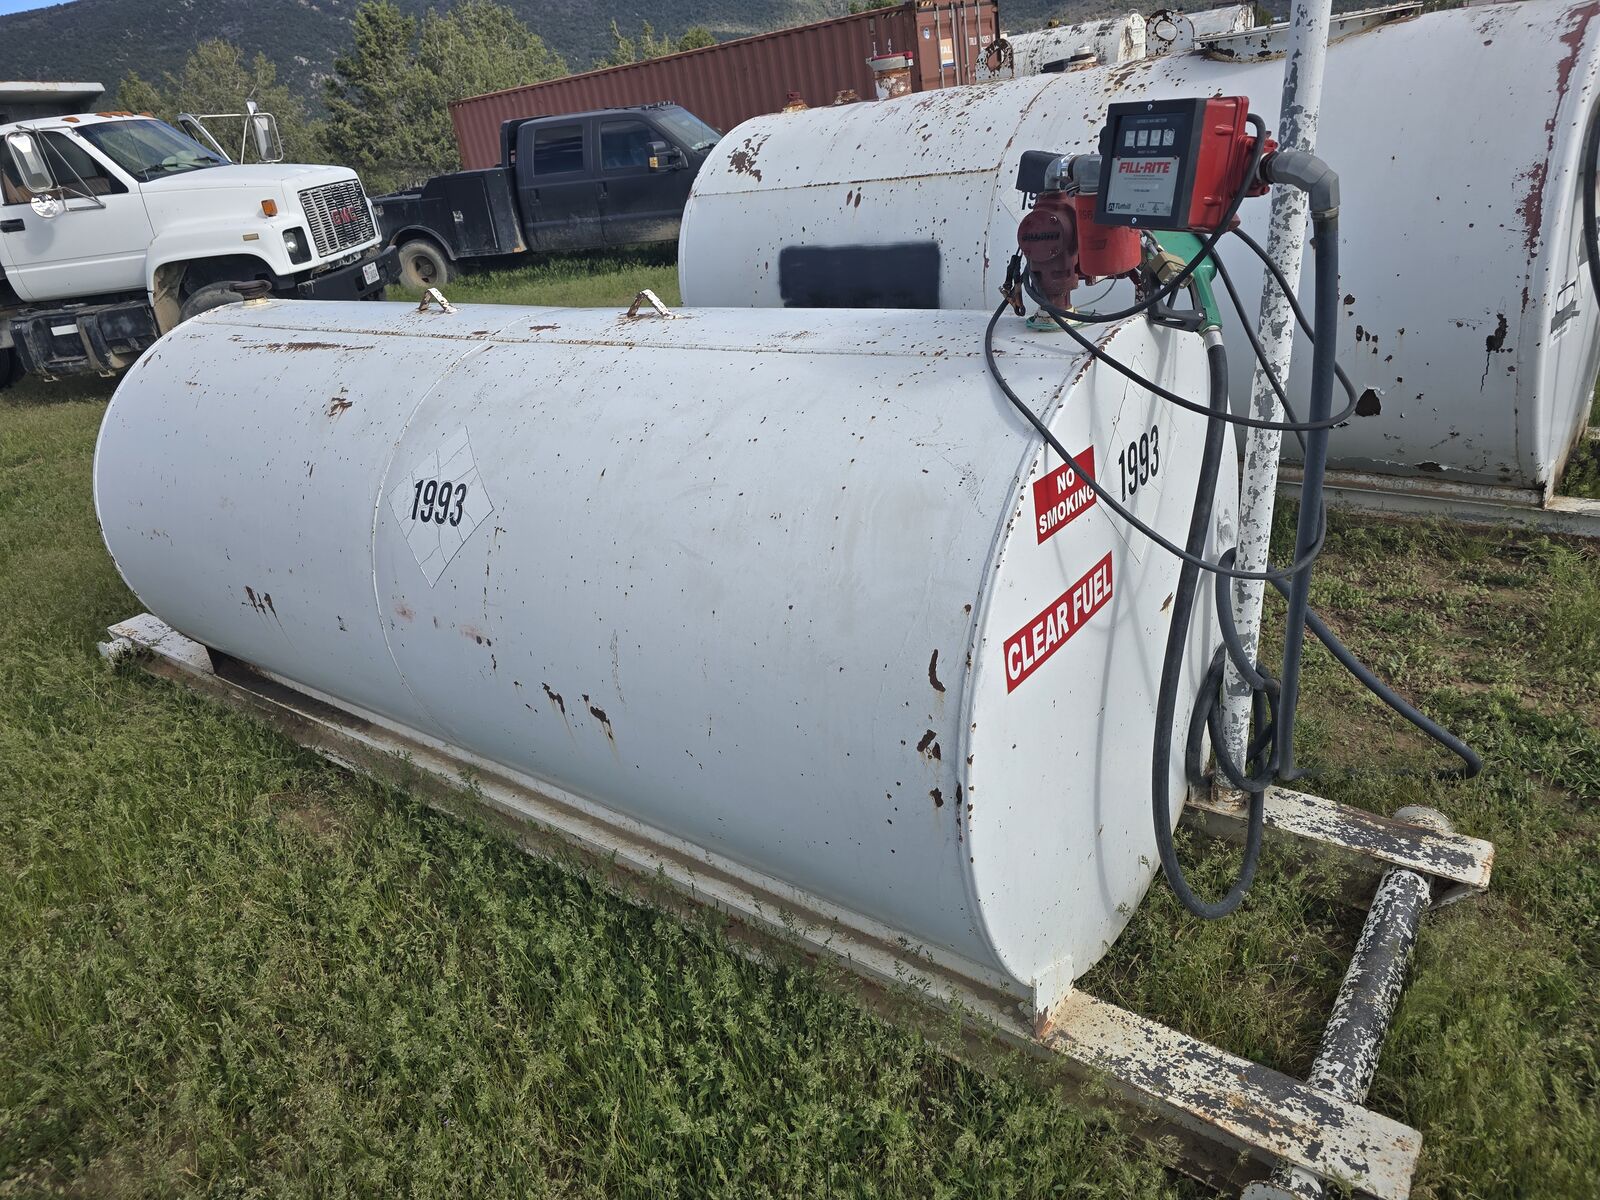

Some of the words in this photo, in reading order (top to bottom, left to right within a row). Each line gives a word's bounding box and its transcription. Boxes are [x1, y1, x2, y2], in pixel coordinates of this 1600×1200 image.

[1118, 161, 1171, 174] FILL-RITE
[331, 206, 358, 225] GMC
[1056, 467, 1075, 495] NO
[1118, 424, 1159, 502] 1993
[411, 479, 467, 527] 1993
[1039, 484, 1095, 534] SMOKING
[1007, 601, 1070, 681] CLEAR
[1073, 563, 1112, 626] FUEL
